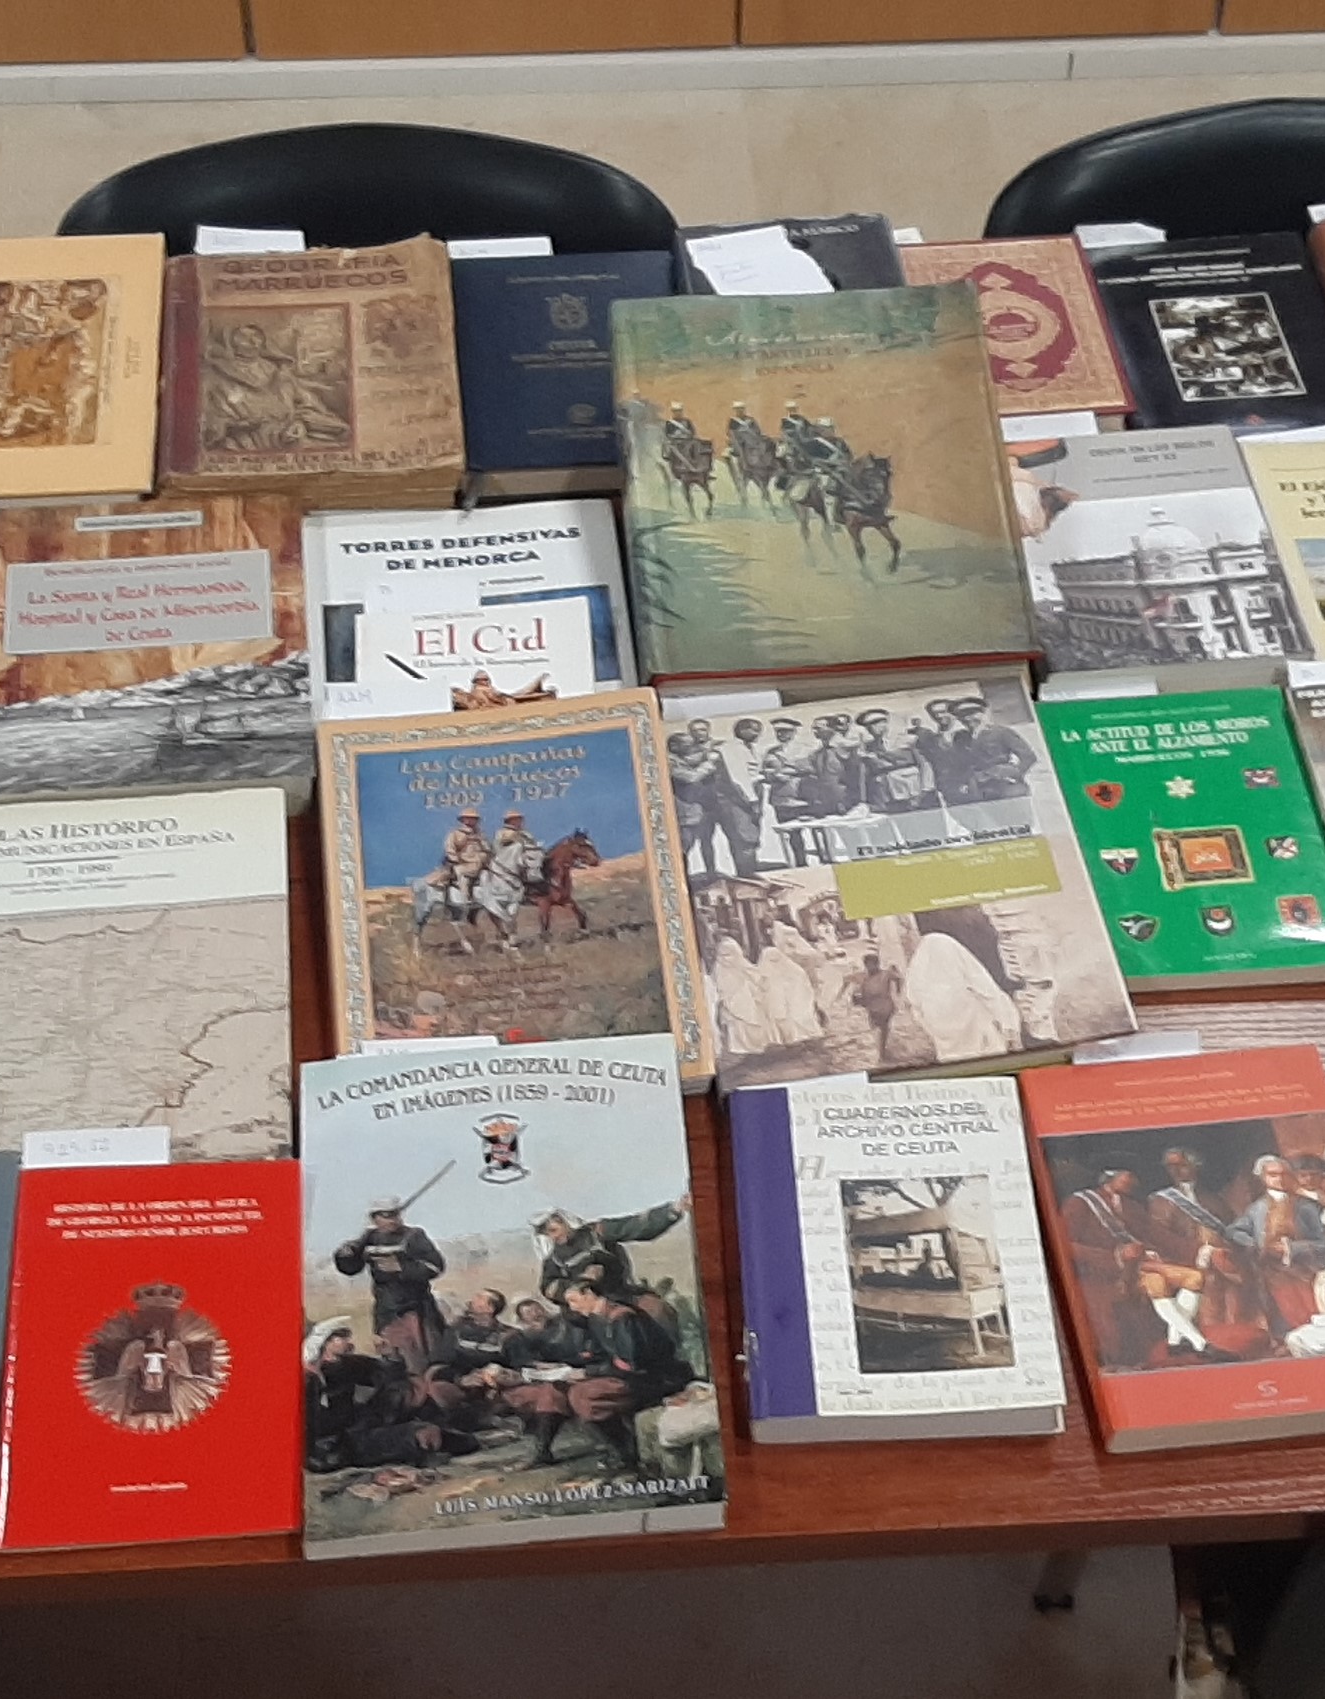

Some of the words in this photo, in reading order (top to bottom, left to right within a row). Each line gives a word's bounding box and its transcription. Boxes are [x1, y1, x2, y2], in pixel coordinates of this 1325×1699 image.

[1278, 481, 1297, 493] El
[340, 538, 435, 556] TORRES
[441, 526, 583, 551] DEFENSIVAS
[384, 557, 418, 572] DE
[422, 549, 542, 571] MENORCA
[414, 621, 459, 658] El
[470, 616, 549, 655] Cid
[1060, 729, 1081, 744] LA
[1085, 723, 1151, 742] ACTITUD
[1153, 721, 1176, 736] DE
[1178, 719, 1211, 735] LOS
[1089, 738, 1130, 755] ANTE
[1132, 736, 1153, 752] EL
[1155, 730, 1251, 751] ALZAMIENTO
[400, 754, 443, 776] Las
[318, 1087, 346, 1111] LA
[345, 1059, 484, 1100] COMANDANCIA
[487, 1056, 574, 1076] GENERAL
[577, 1059, 603, 1077] DE
[607, 1062, 669, 1087] CEUTA
[371, 1102, 400, 1121] EN
[823, 1102, 947, 1121] CUADERNOS
[948, 1101, 988, 1118] DEL
[816, 1121, 905, 1141] ARCHIVO
[908, 1117, 1000, 1139] CENTRAL
[861, 1141, 891, 1157] DE
[893, 1139, 962, 1157] CEUTA
